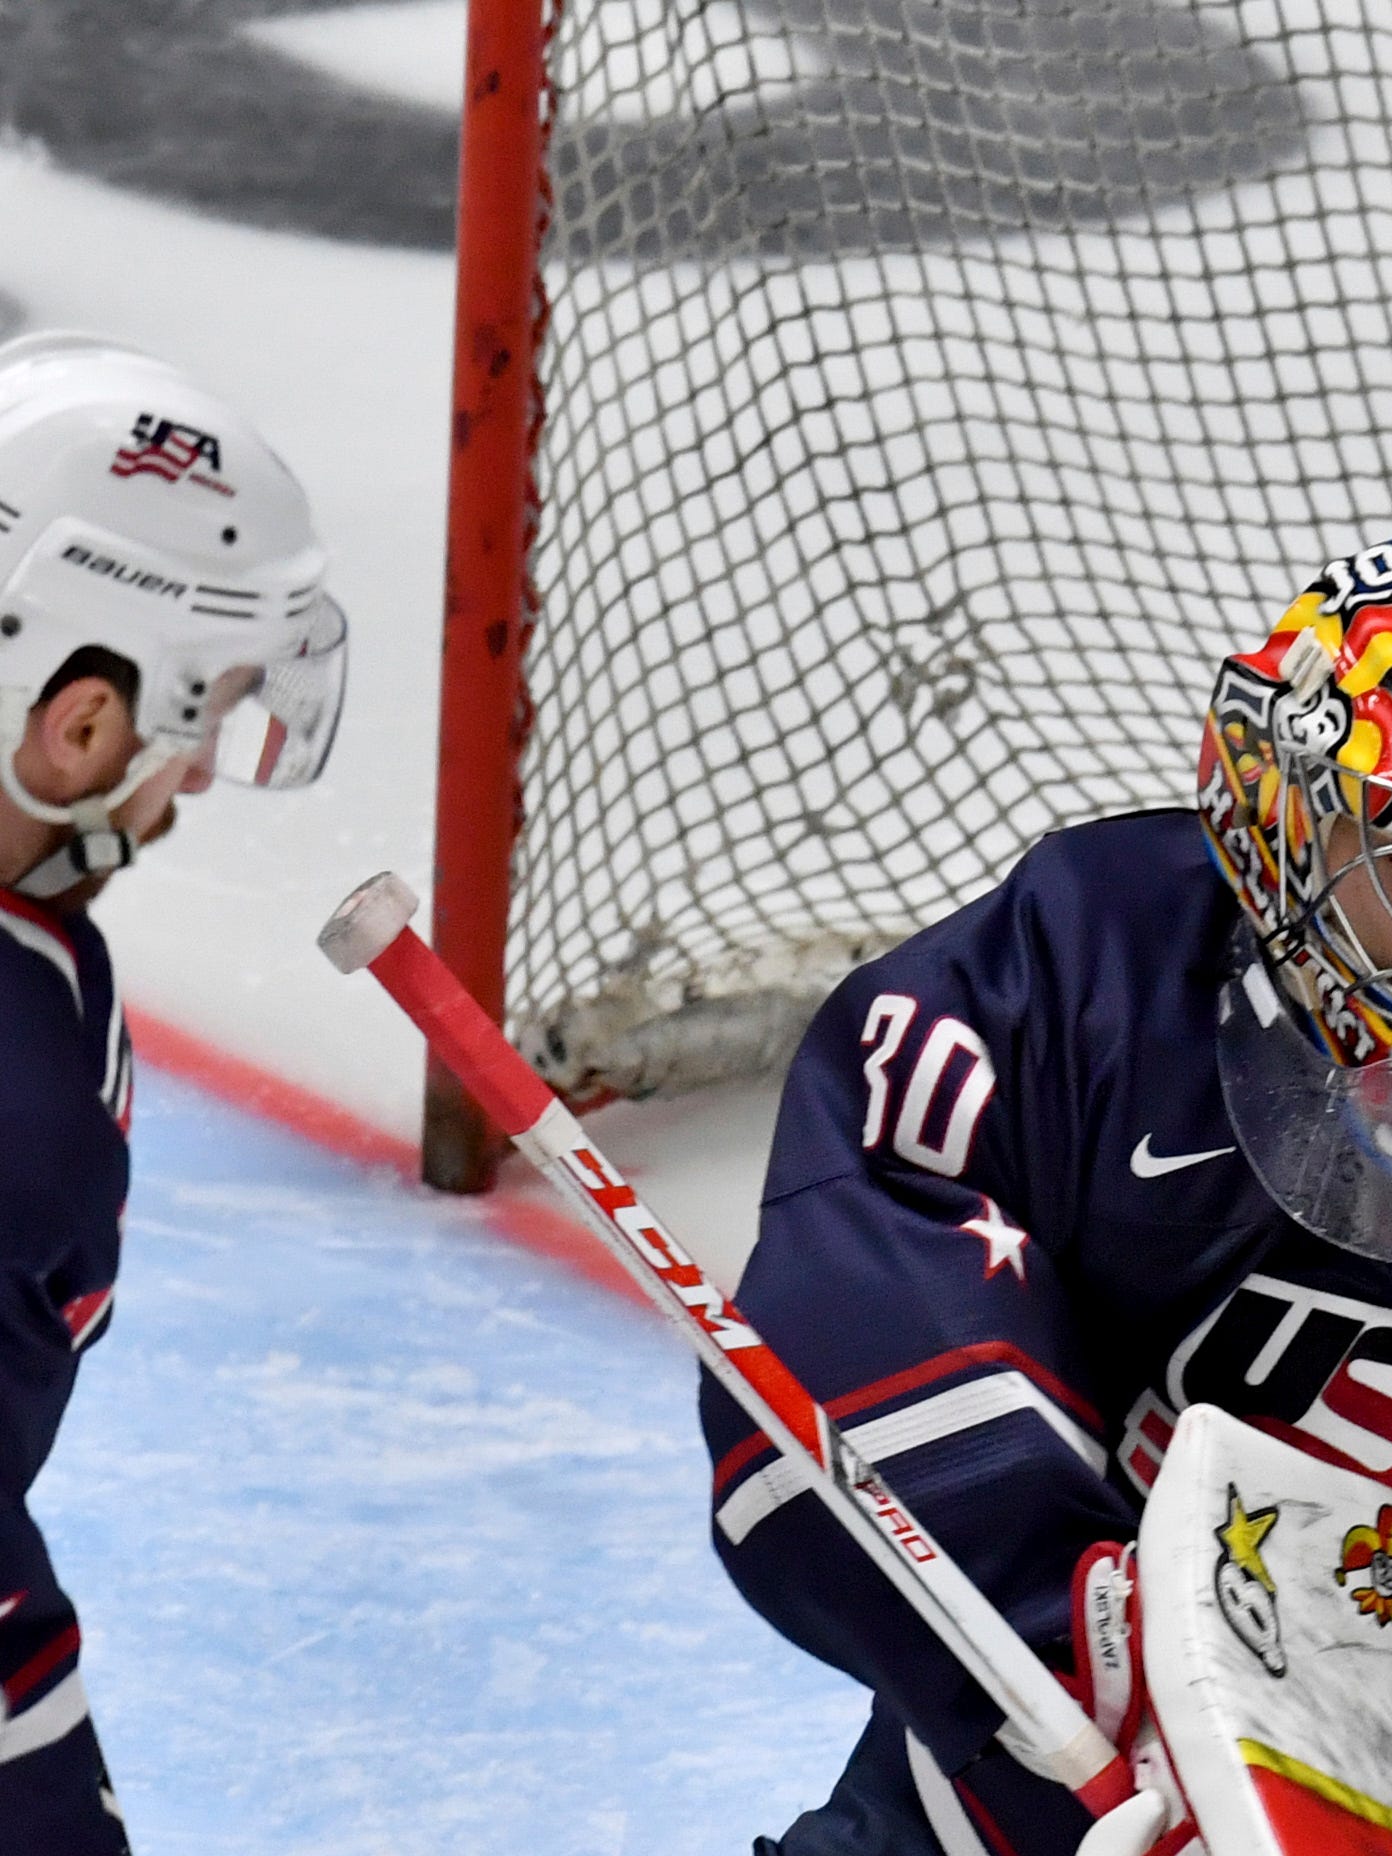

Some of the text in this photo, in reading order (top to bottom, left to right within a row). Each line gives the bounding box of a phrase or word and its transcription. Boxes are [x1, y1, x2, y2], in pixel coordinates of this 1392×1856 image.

[60, 542, 188, 600] BAUER
[555, 1146, 937, 1564] CCM PRO
